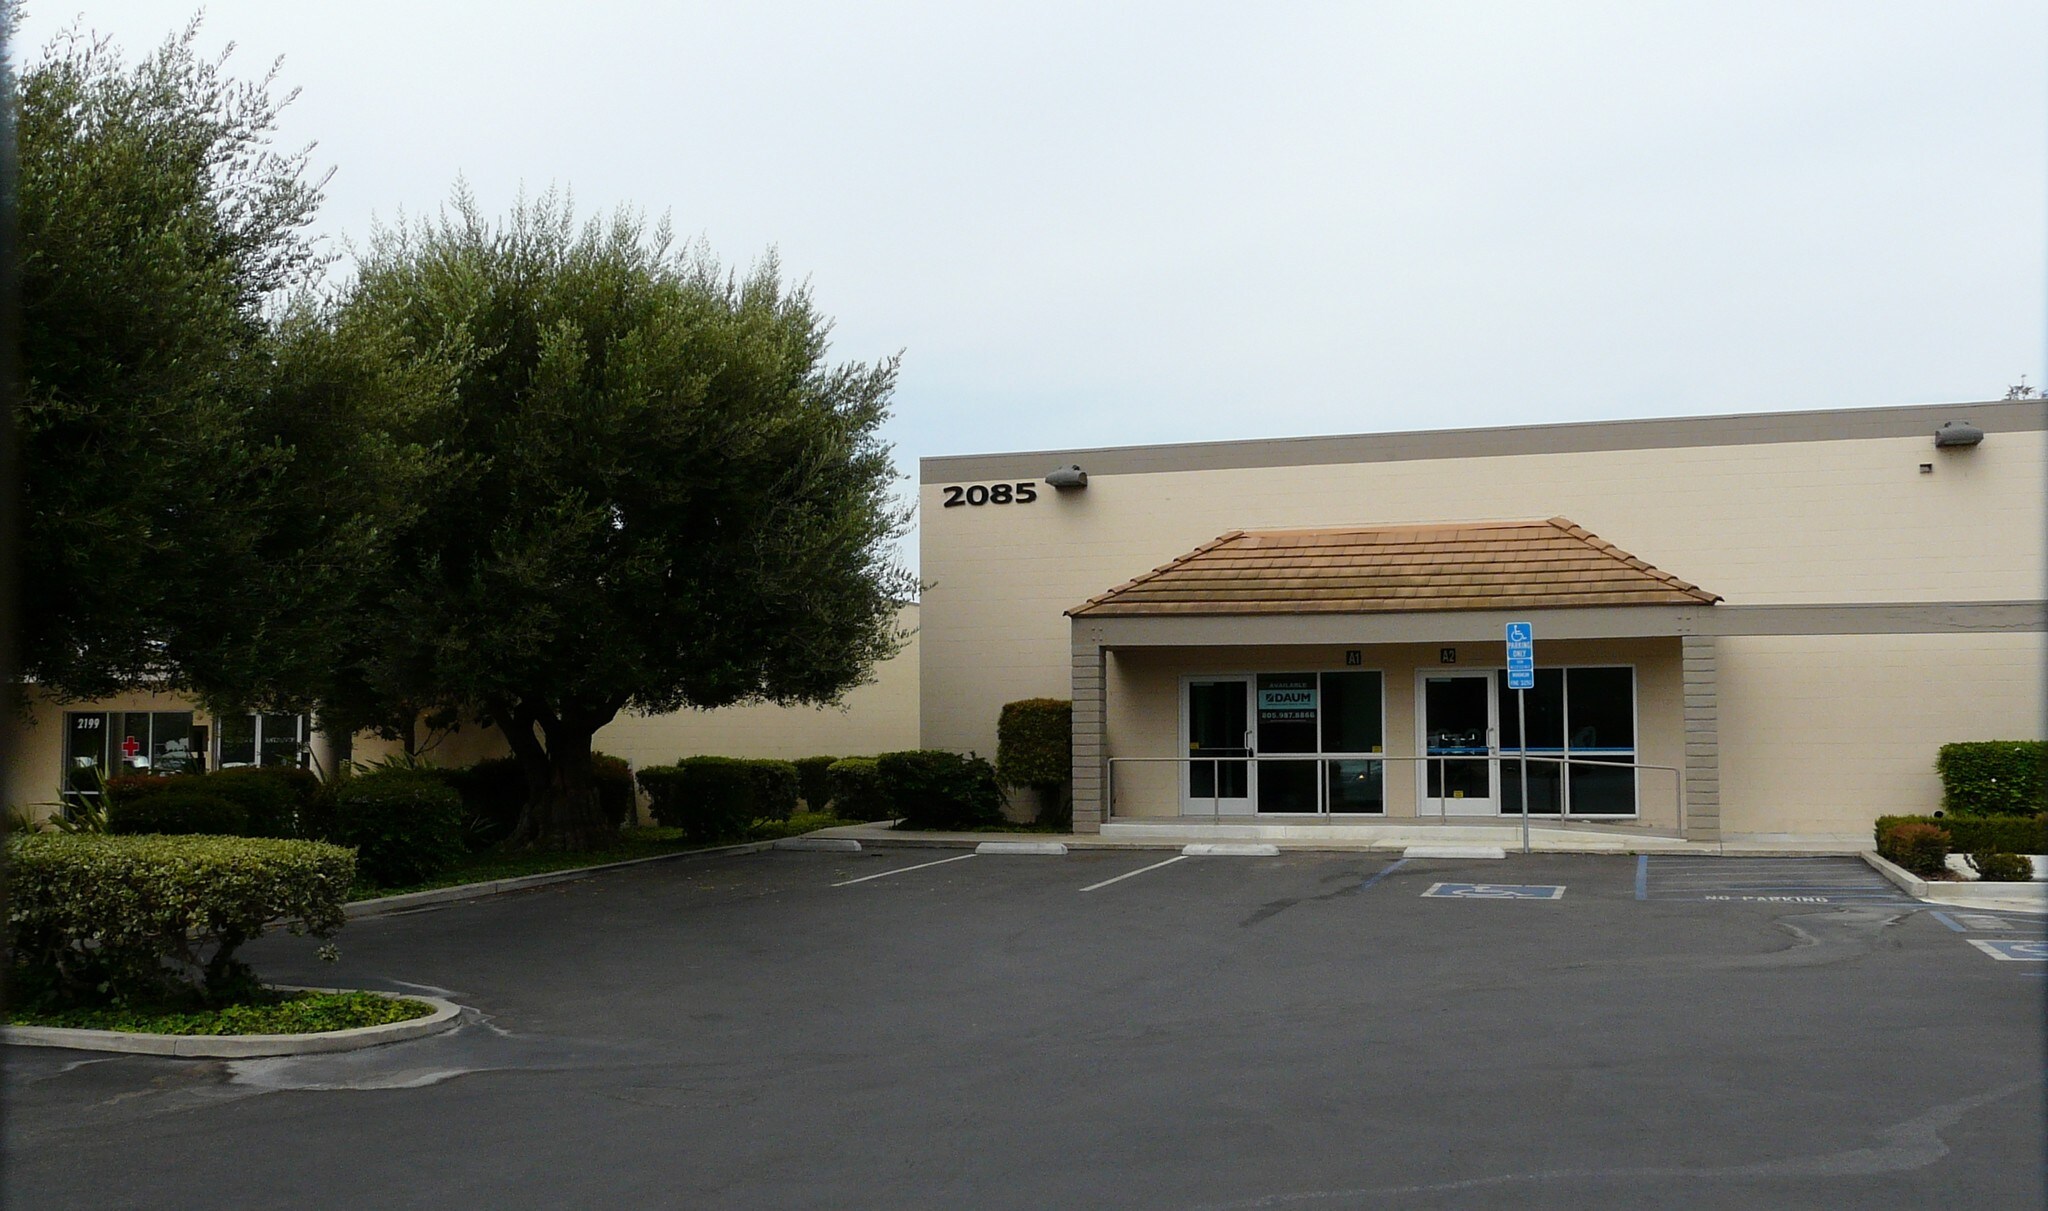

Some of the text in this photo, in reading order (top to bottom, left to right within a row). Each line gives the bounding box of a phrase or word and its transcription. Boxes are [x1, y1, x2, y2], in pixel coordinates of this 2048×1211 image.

[943, 482, 1037, 508] 2085
[1508, 641, 1531, 649] PARKING
[1348, 652, 1360, 664] A1
[1442, 650, 1455, 662] A2
[1512, 649, 1526, 657] ONLY
[1275, 693, 1311, 702] DAUM
[77, 718, 100, 730] 2199
